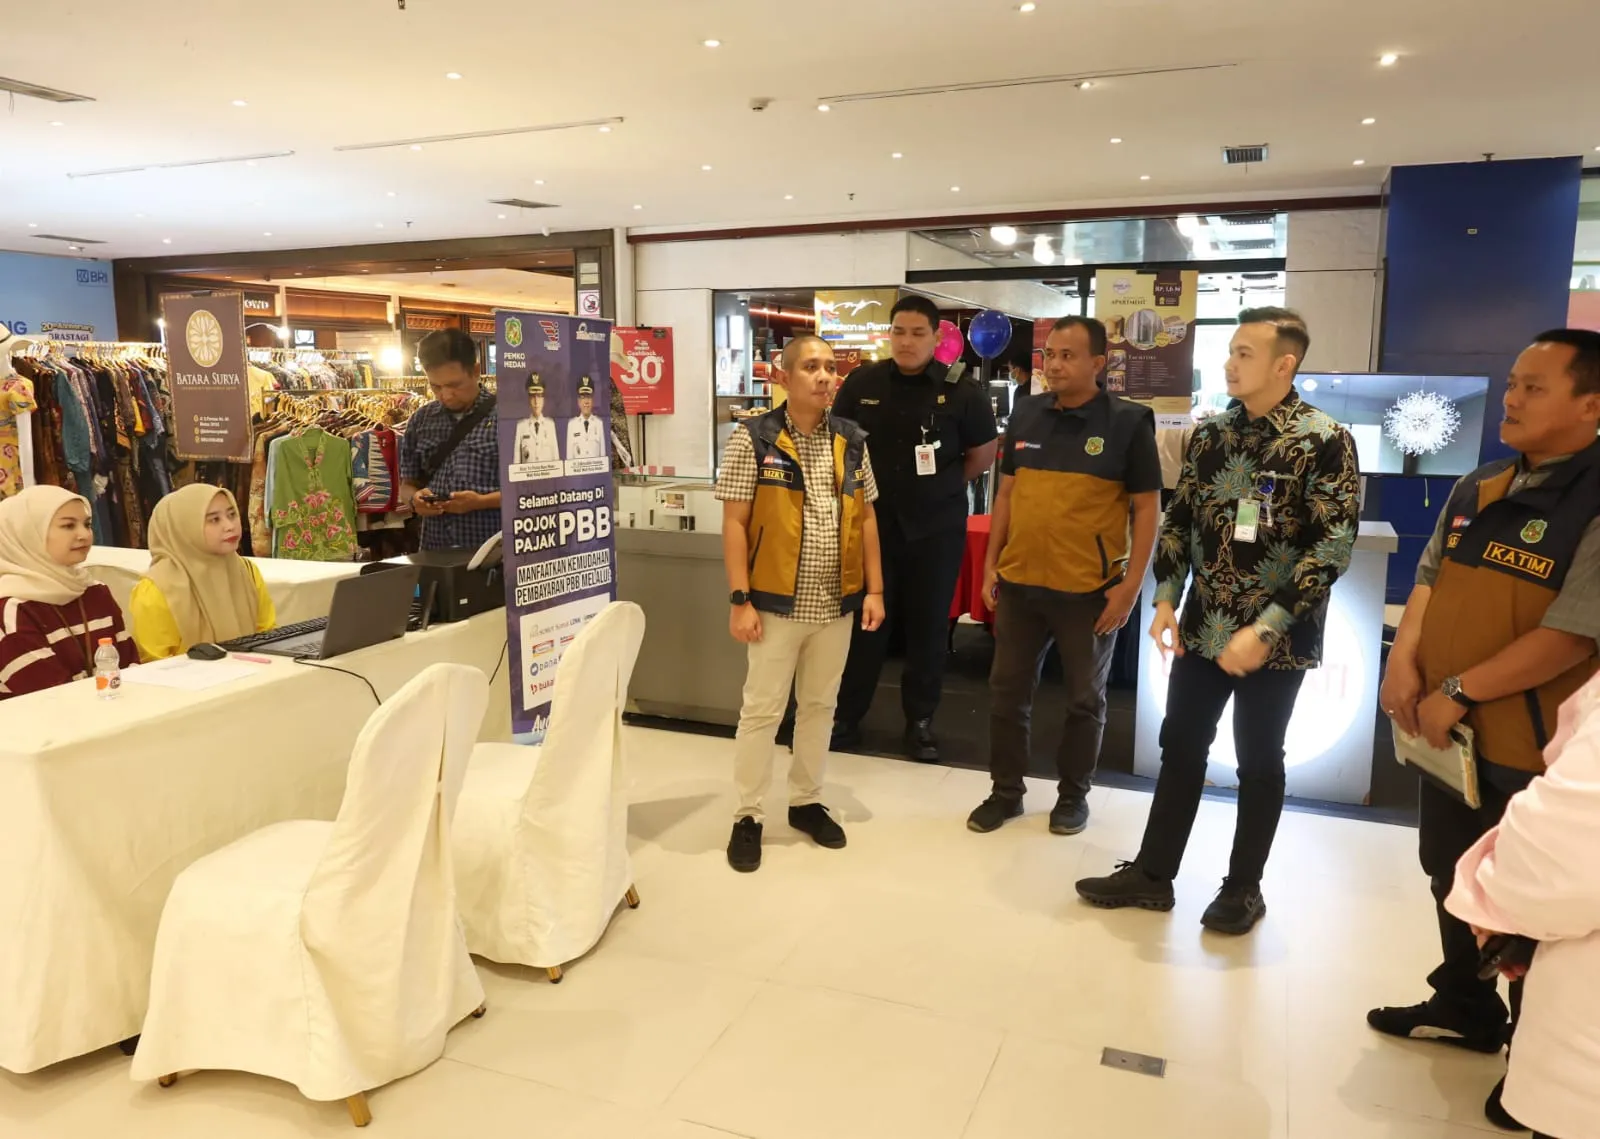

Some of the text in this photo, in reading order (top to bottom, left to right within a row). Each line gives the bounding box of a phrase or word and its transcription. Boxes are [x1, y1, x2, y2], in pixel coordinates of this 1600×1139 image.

[90, 271, 108, 283] BRI
[503, 352, 526, 360] PEMKO
[176, 372, 240, 385] BATARA SURYA
[519, 486, 605, 510] Selamat Datang Di
[513, 513, 558, 536] POJOK
[558, 505, 611, 546] PBB
[514, 532, 557, 554] PAJAK
[518, 550, 609, 583] MANFAATKAN KEMUDAHAN
[1490, 545, 1548, 574] KATIM
[516, 580, 565, 605] PEMBAYARAN
[566, 575, 580, 592] PBB
